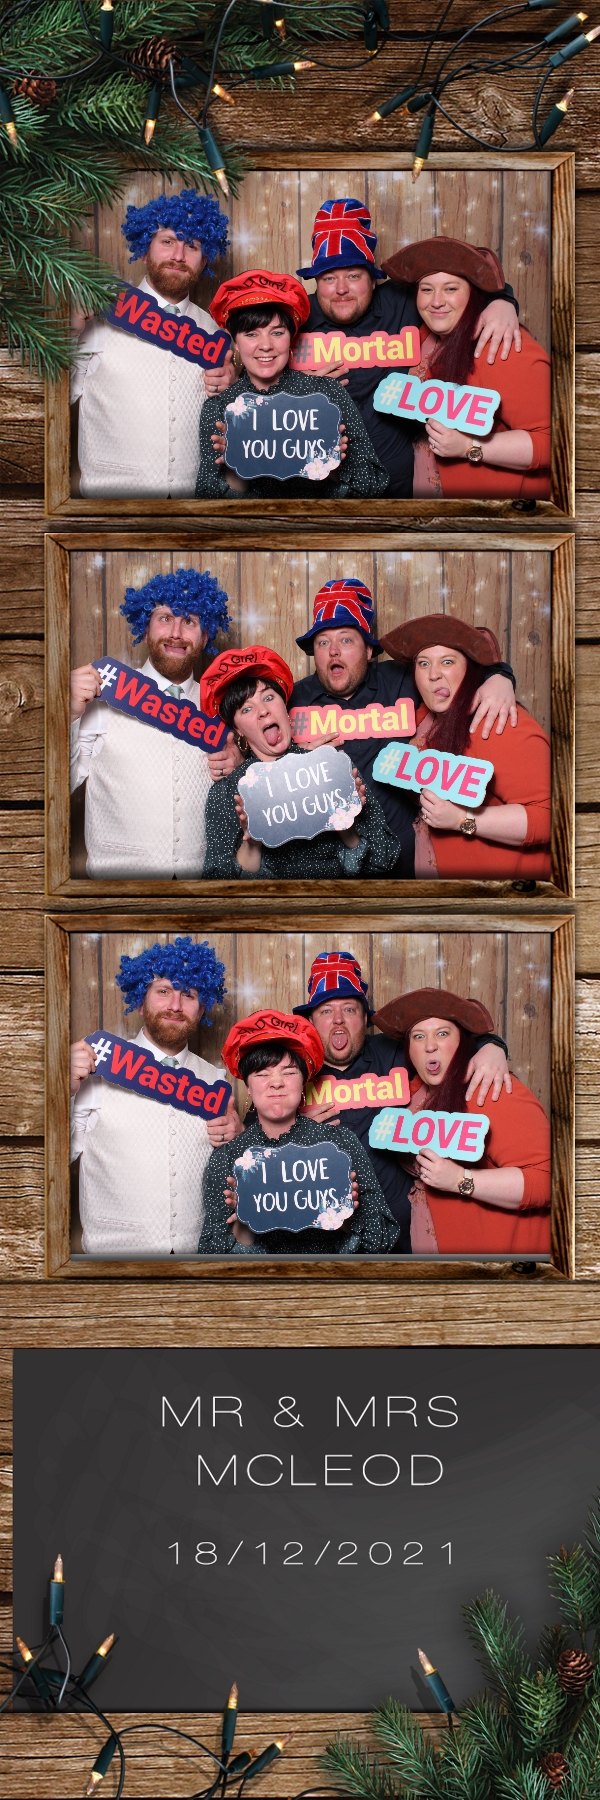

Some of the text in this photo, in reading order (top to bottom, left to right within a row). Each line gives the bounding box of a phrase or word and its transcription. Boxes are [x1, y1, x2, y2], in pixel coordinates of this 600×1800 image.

[102, 282, 226, 364] Wasted
[293, 332, 414, 364] #Mortal
[272, 409, 319, 431] LOVE
[380, 379, 494, 427] #LOVE
[242, 439, 327, 460] YOU GUYS
[97, 663, 226, 748] #Wasted
[291, 703, 409, 736] #Mortal
[265, 761, 333, 798] I LOVE
[379, 748, 486, 799] #LOVE
[262, 788, 347, 827] YOU GUYS
[271, 1016, 299, 1035] GIRL
[90, 1037, 227, 1115] #Wasted
[374, 1114, 483, 1153] #LOVE
[281, 1158, 330, 1184] LOVE
[253, 1188, 340, 1213] YOU GUYS
